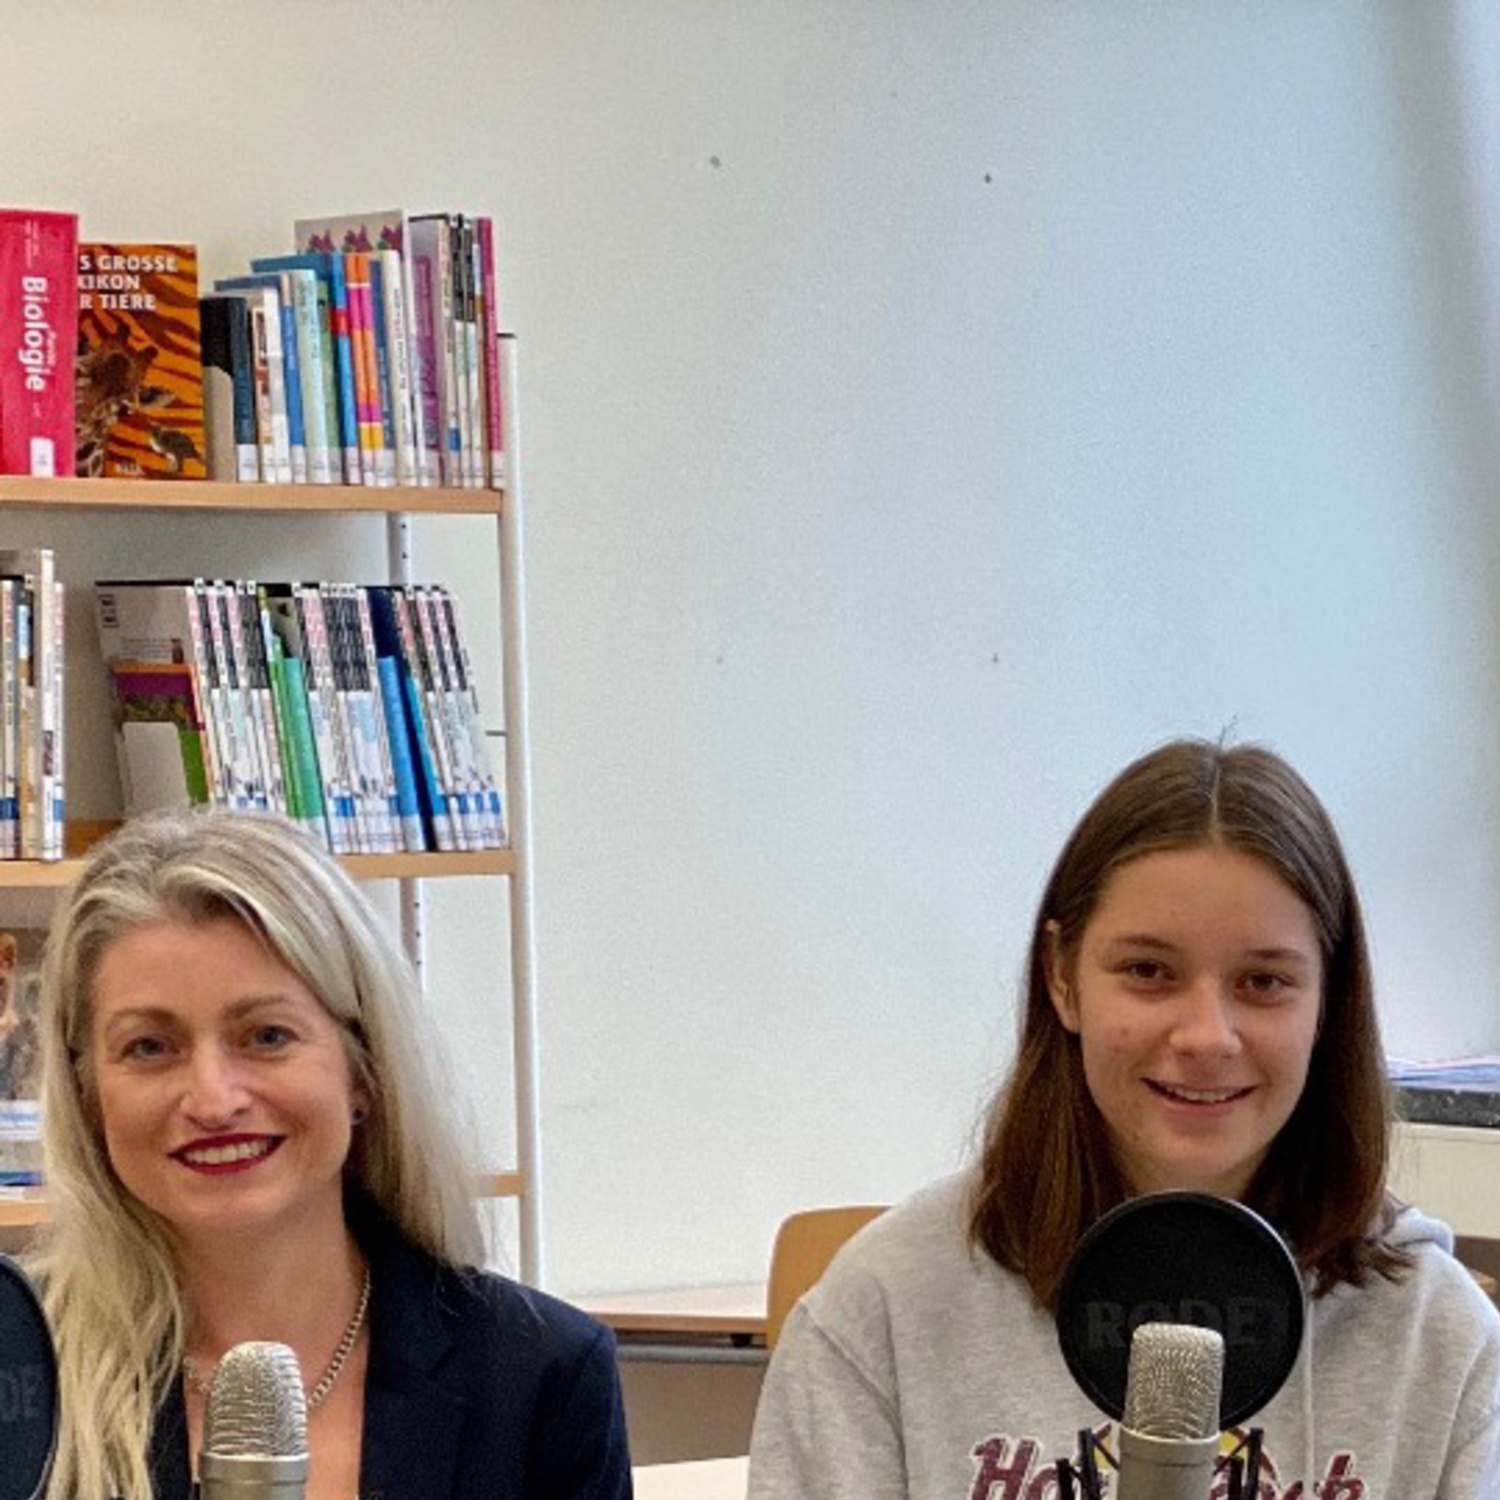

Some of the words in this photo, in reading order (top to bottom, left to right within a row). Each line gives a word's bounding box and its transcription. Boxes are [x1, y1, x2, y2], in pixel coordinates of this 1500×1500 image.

[96, 255, 178, 272] GROSSE
[99, 294, 157, 310] TIERE
[18, 276, 50, 391] Biologie
